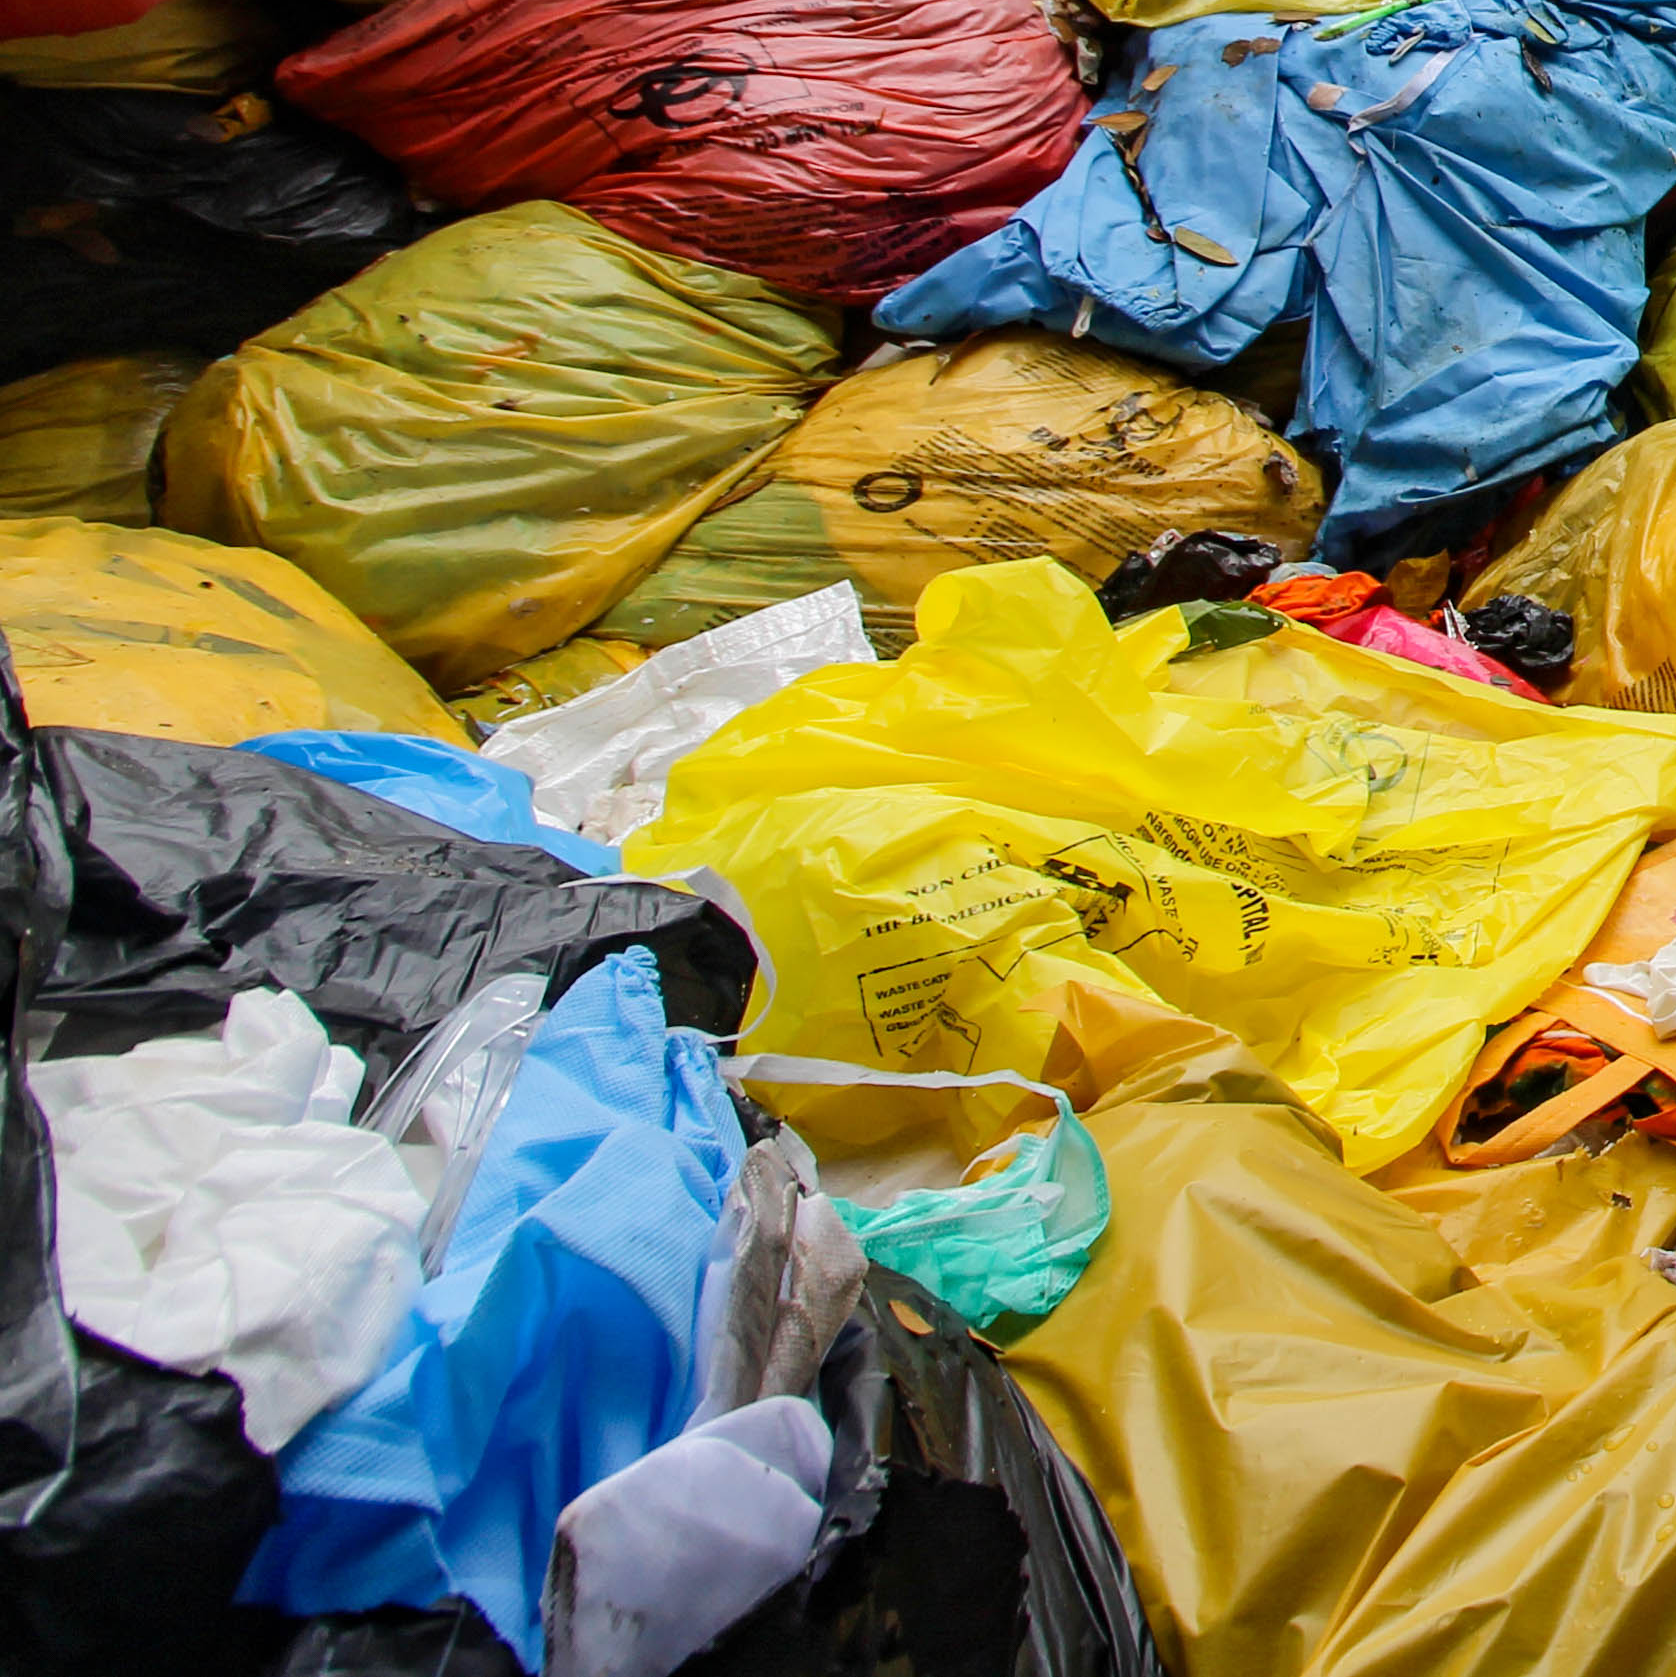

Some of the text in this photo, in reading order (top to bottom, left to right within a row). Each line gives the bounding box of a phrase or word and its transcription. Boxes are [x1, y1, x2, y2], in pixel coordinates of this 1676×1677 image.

[1171, 811, 1205, 849] MCGM
[1199, 845, 1224, 870] USE
[905, 877, 954, 896] NON
[874, 983, 919, 1000] WASTE
[880, 1002, 924, 1018] WASTE
